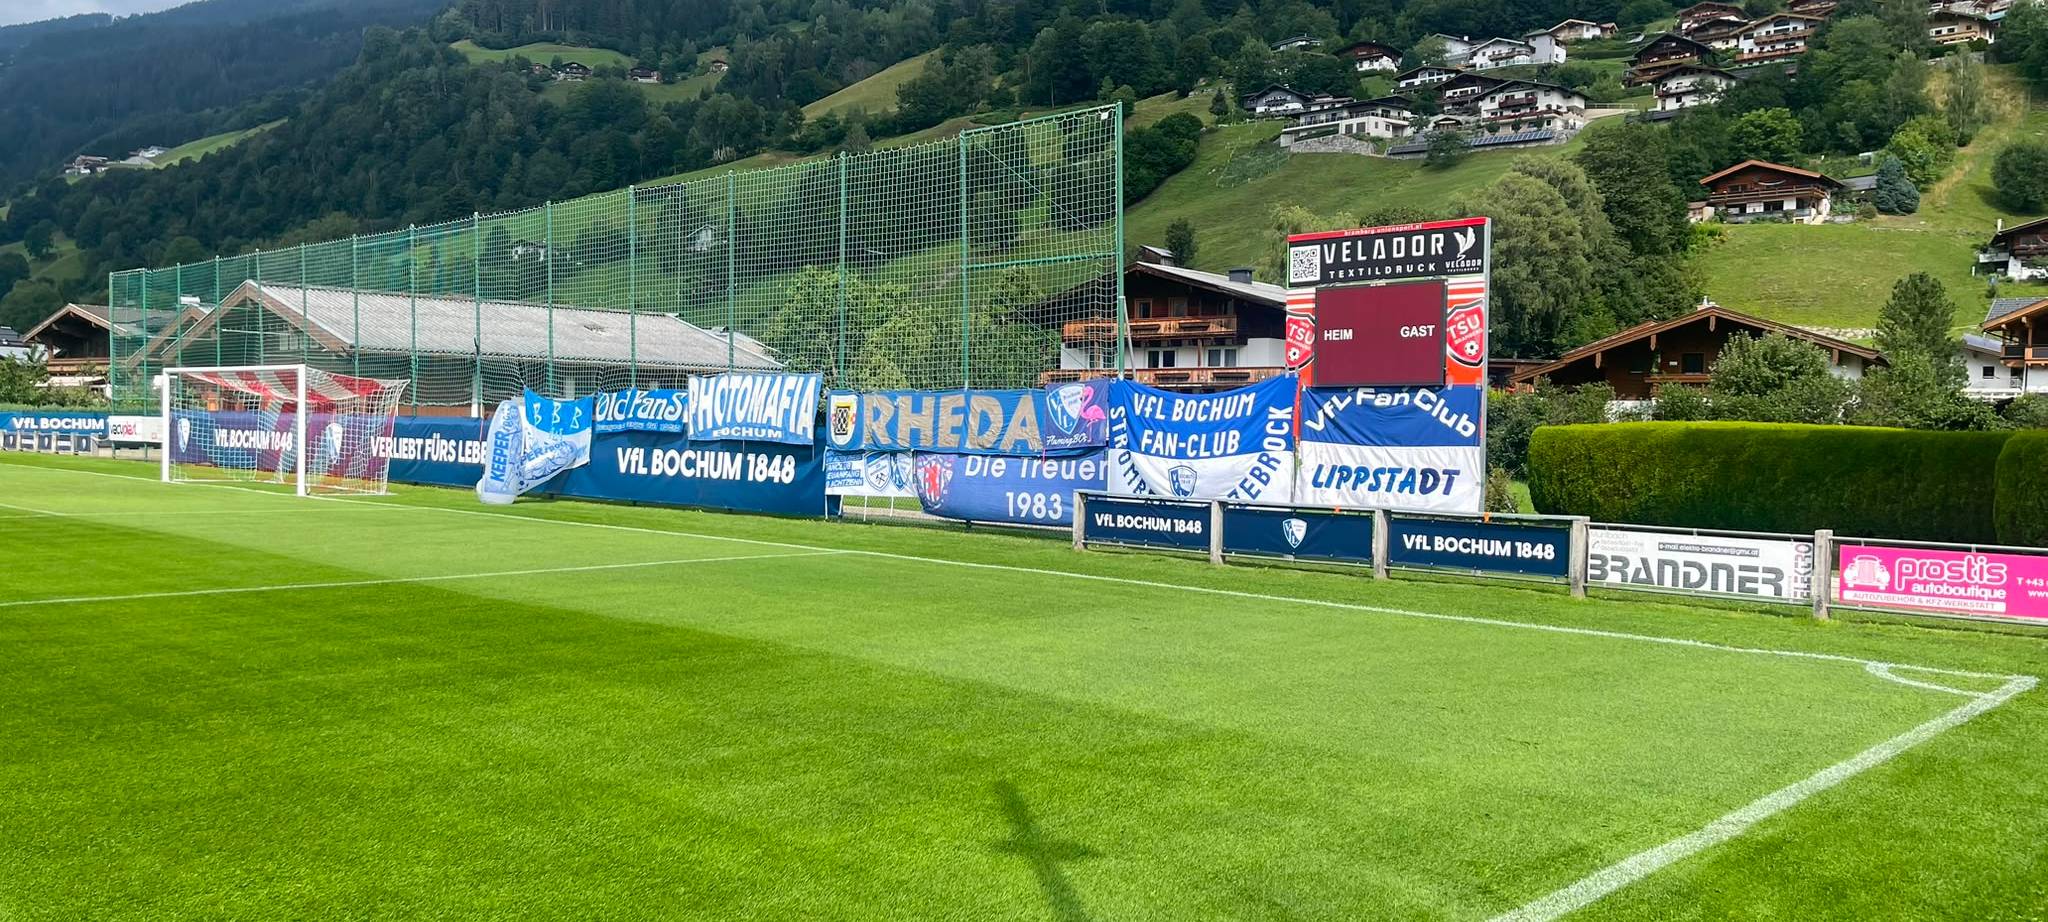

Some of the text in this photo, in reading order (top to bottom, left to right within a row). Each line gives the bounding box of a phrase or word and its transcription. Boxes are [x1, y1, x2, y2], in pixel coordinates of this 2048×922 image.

[1324, 233, 1444, 264] VELADOR
[1329, 262, 1436, 279] TEXTILDRUCK
[1290, 323, 1315, 345] TSU
[1324, 328, 1353, 341] HEIM
[1400, 325, 1435, 338] GAST
[1447, 314, 1480, 340] TSU
[688, 374, 816, 441] PHOTOMAFIA
[1134, 392, 1256, 422] VfL BOCHUM
[1305, 388, 1476, 437] VfL Fan Club
[13, 417, 104, 430] VfL BOCHUM
[713, 426, 782, 438] BOCHUM
[863, 394, 1044, 452] RHEDA
[215, 428, 293, 451] VfL BOCHUM 1848
[370, 436, 423, 460] VERLIEBT
[424, 433, 456, 462] FÜRS
[1141, 429, 1241, 457] FAN-CLUB
[617, 447, 796, 484] VfL BOCHUM 1848
[965, 455, 1006, 477] Die
[1312, 464, 1460, 496] LIPPSTADT
[1006, 491, 1063, 520] 1983
[1095, 513, 1202, 534] VfL BOCHUM 1848
[1402, 533, 1555, 560] VfL BOCHUM 1848
[1590, 553, 1785, 597] BRANDNER
[1895, 555, 2007, 591] prostis
[2016, 576, 2024, 585] T
[1912, 583, 2007, 601] autoboutique
